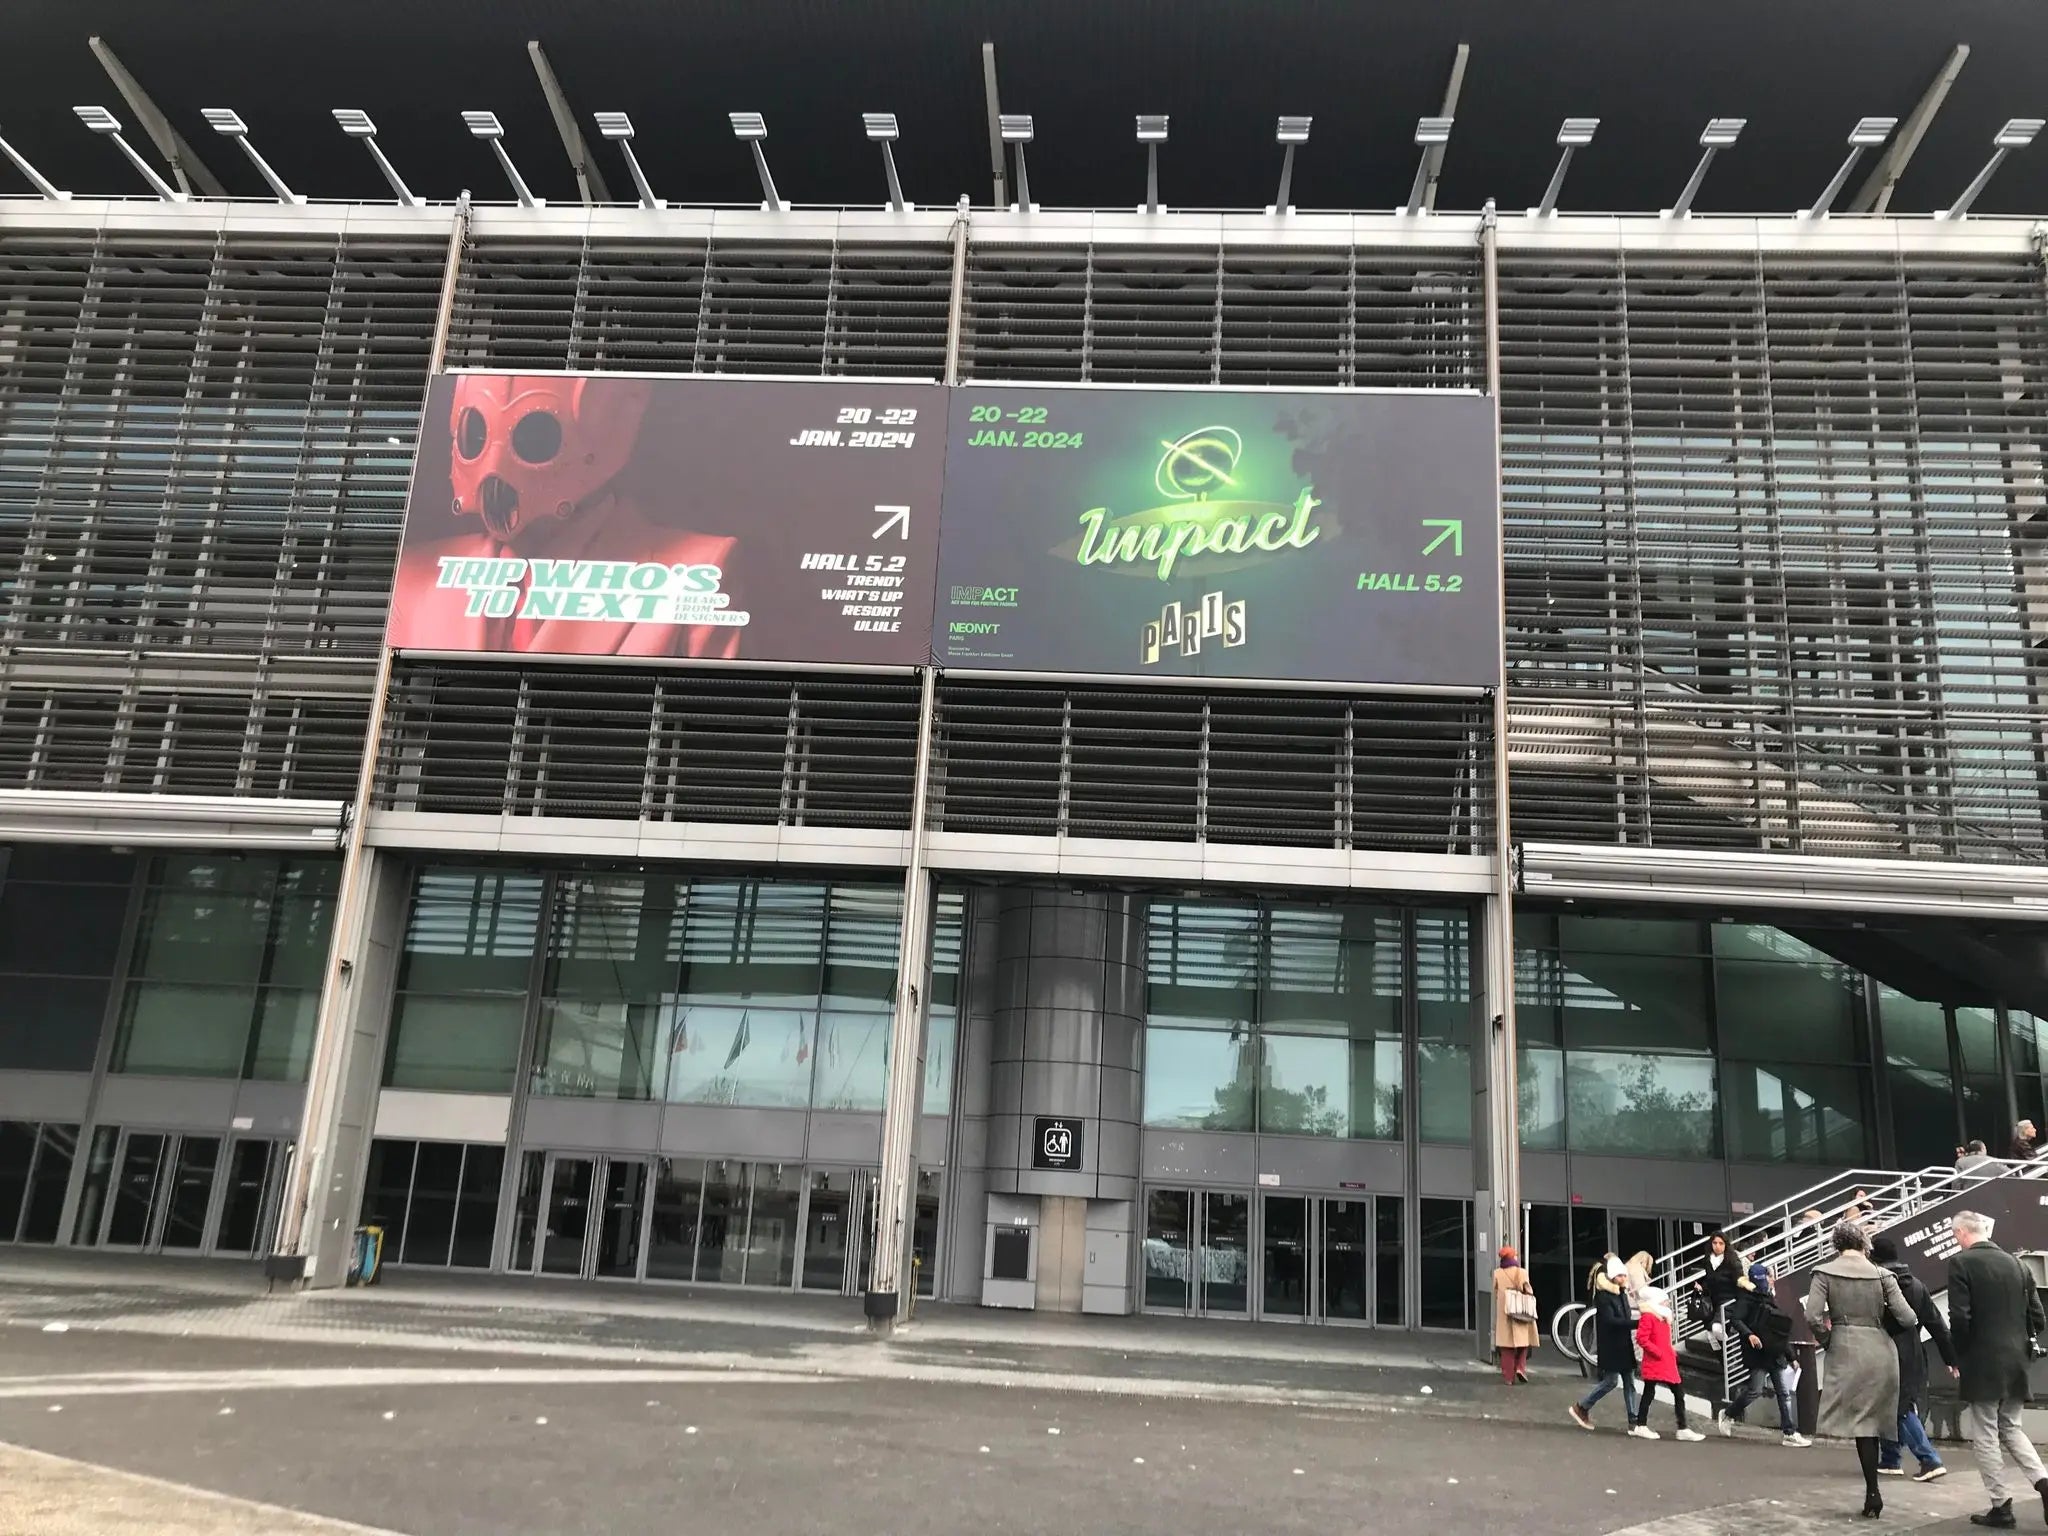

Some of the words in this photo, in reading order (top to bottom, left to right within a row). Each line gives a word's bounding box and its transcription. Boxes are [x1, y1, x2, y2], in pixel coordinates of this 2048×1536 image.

[837, 407, 872, 424] 20
[968, 406, 1002, 422] 20
[789, 430, 845, 447] JAN.
[848, 431, 915, 448] 2024
[967, 430, 1019, 447] JAN.
[1022, 431, 1083, 449] 2024
[1076, 485, 1322, 582] Impact
[800, 553, 860, 571] HALL
[864, 555, 907, 572] 5.2
[438, 558, 527, 587] TRIP
[532, 561, 719, 592] WHO'S
[846, 574, 905, 587] TRENDY
[1356, 572, 1420, 591] HALL
[1423, 574, 1463, 592] 5.2
[467, 587, 518, 615] TO
[675, 594, 727, 605] FREAKS
[821, 588, 880, 602] WHAT'S
[880, 591, 904, 602] UP
[950, 585, 1019, 602] IMPACT
[522, 590, 669, 620] NEXT
[674, 603, 712, 613] FROM
[841, 604, 903, 617] RESORT
[673, 612, 746, 623] DESIGNERS
[853, 620, 902, 633] ULULE
[949, 622, 1000, 634] NEONYT
[1140, 592, 1246, 665] PARIS
[1903, 1227, 1934, 1248] HALL
[1932, 1216, 1952, 1234] 5.2
[1930, 1229, 1954, 1245] TREND
